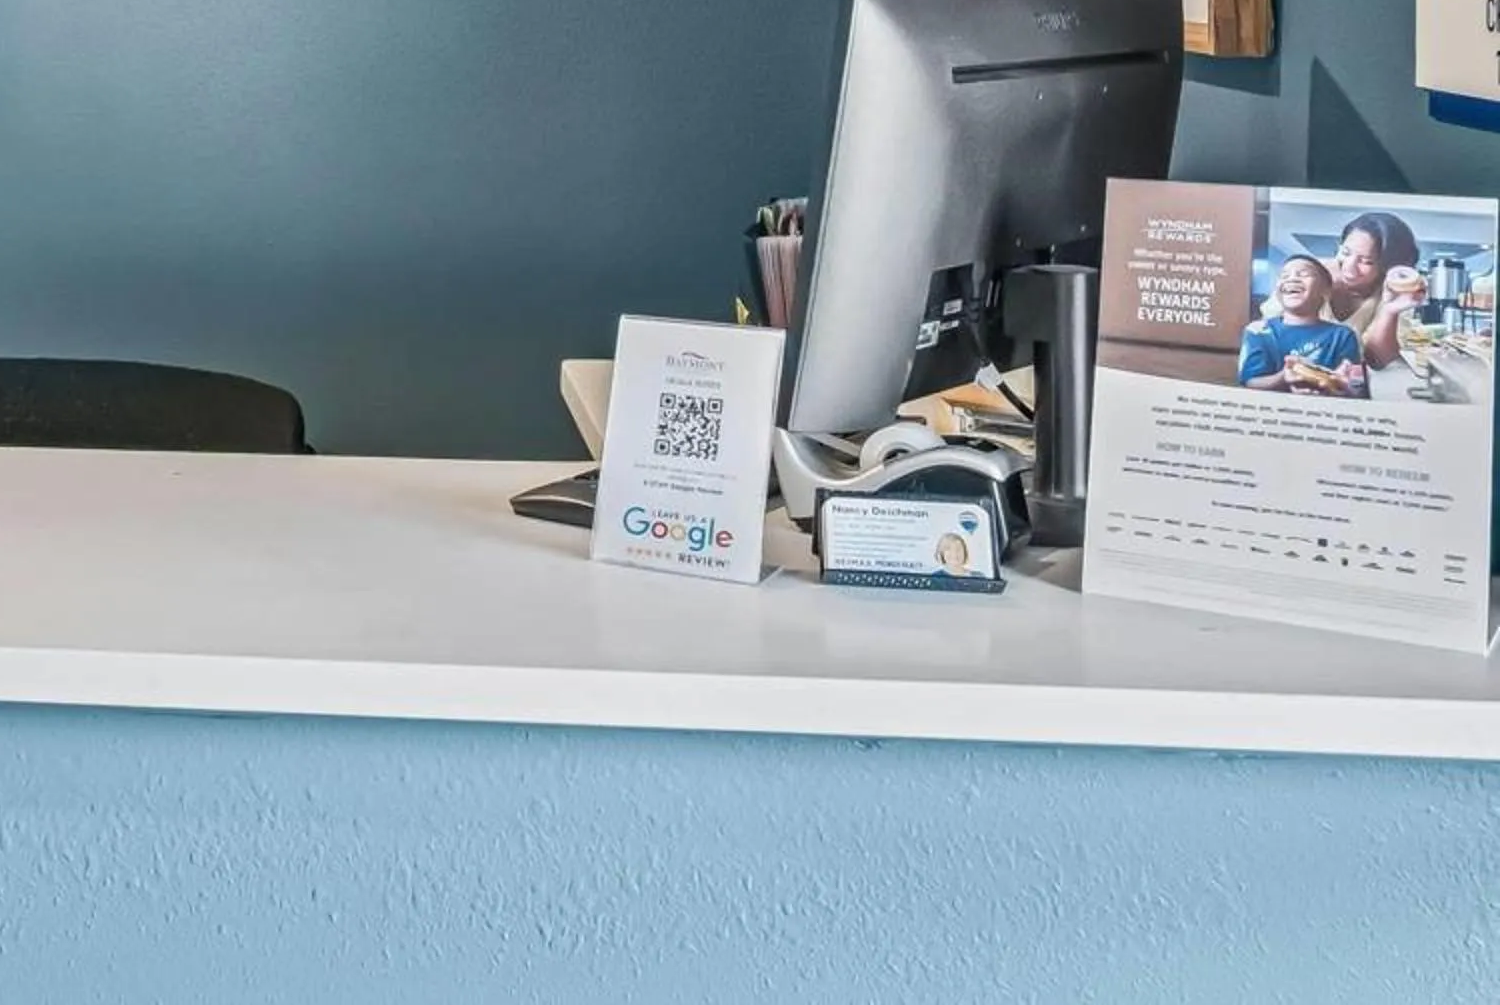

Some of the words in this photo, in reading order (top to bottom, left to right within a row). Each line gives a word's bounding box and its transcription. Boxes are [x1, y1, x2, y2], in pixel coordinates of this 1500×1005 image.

[1137, 276, 1215, 294] WYNDHAM
[1140, 292, 1211, 310] REWARDS
[622, 506, 734, 552] Google
